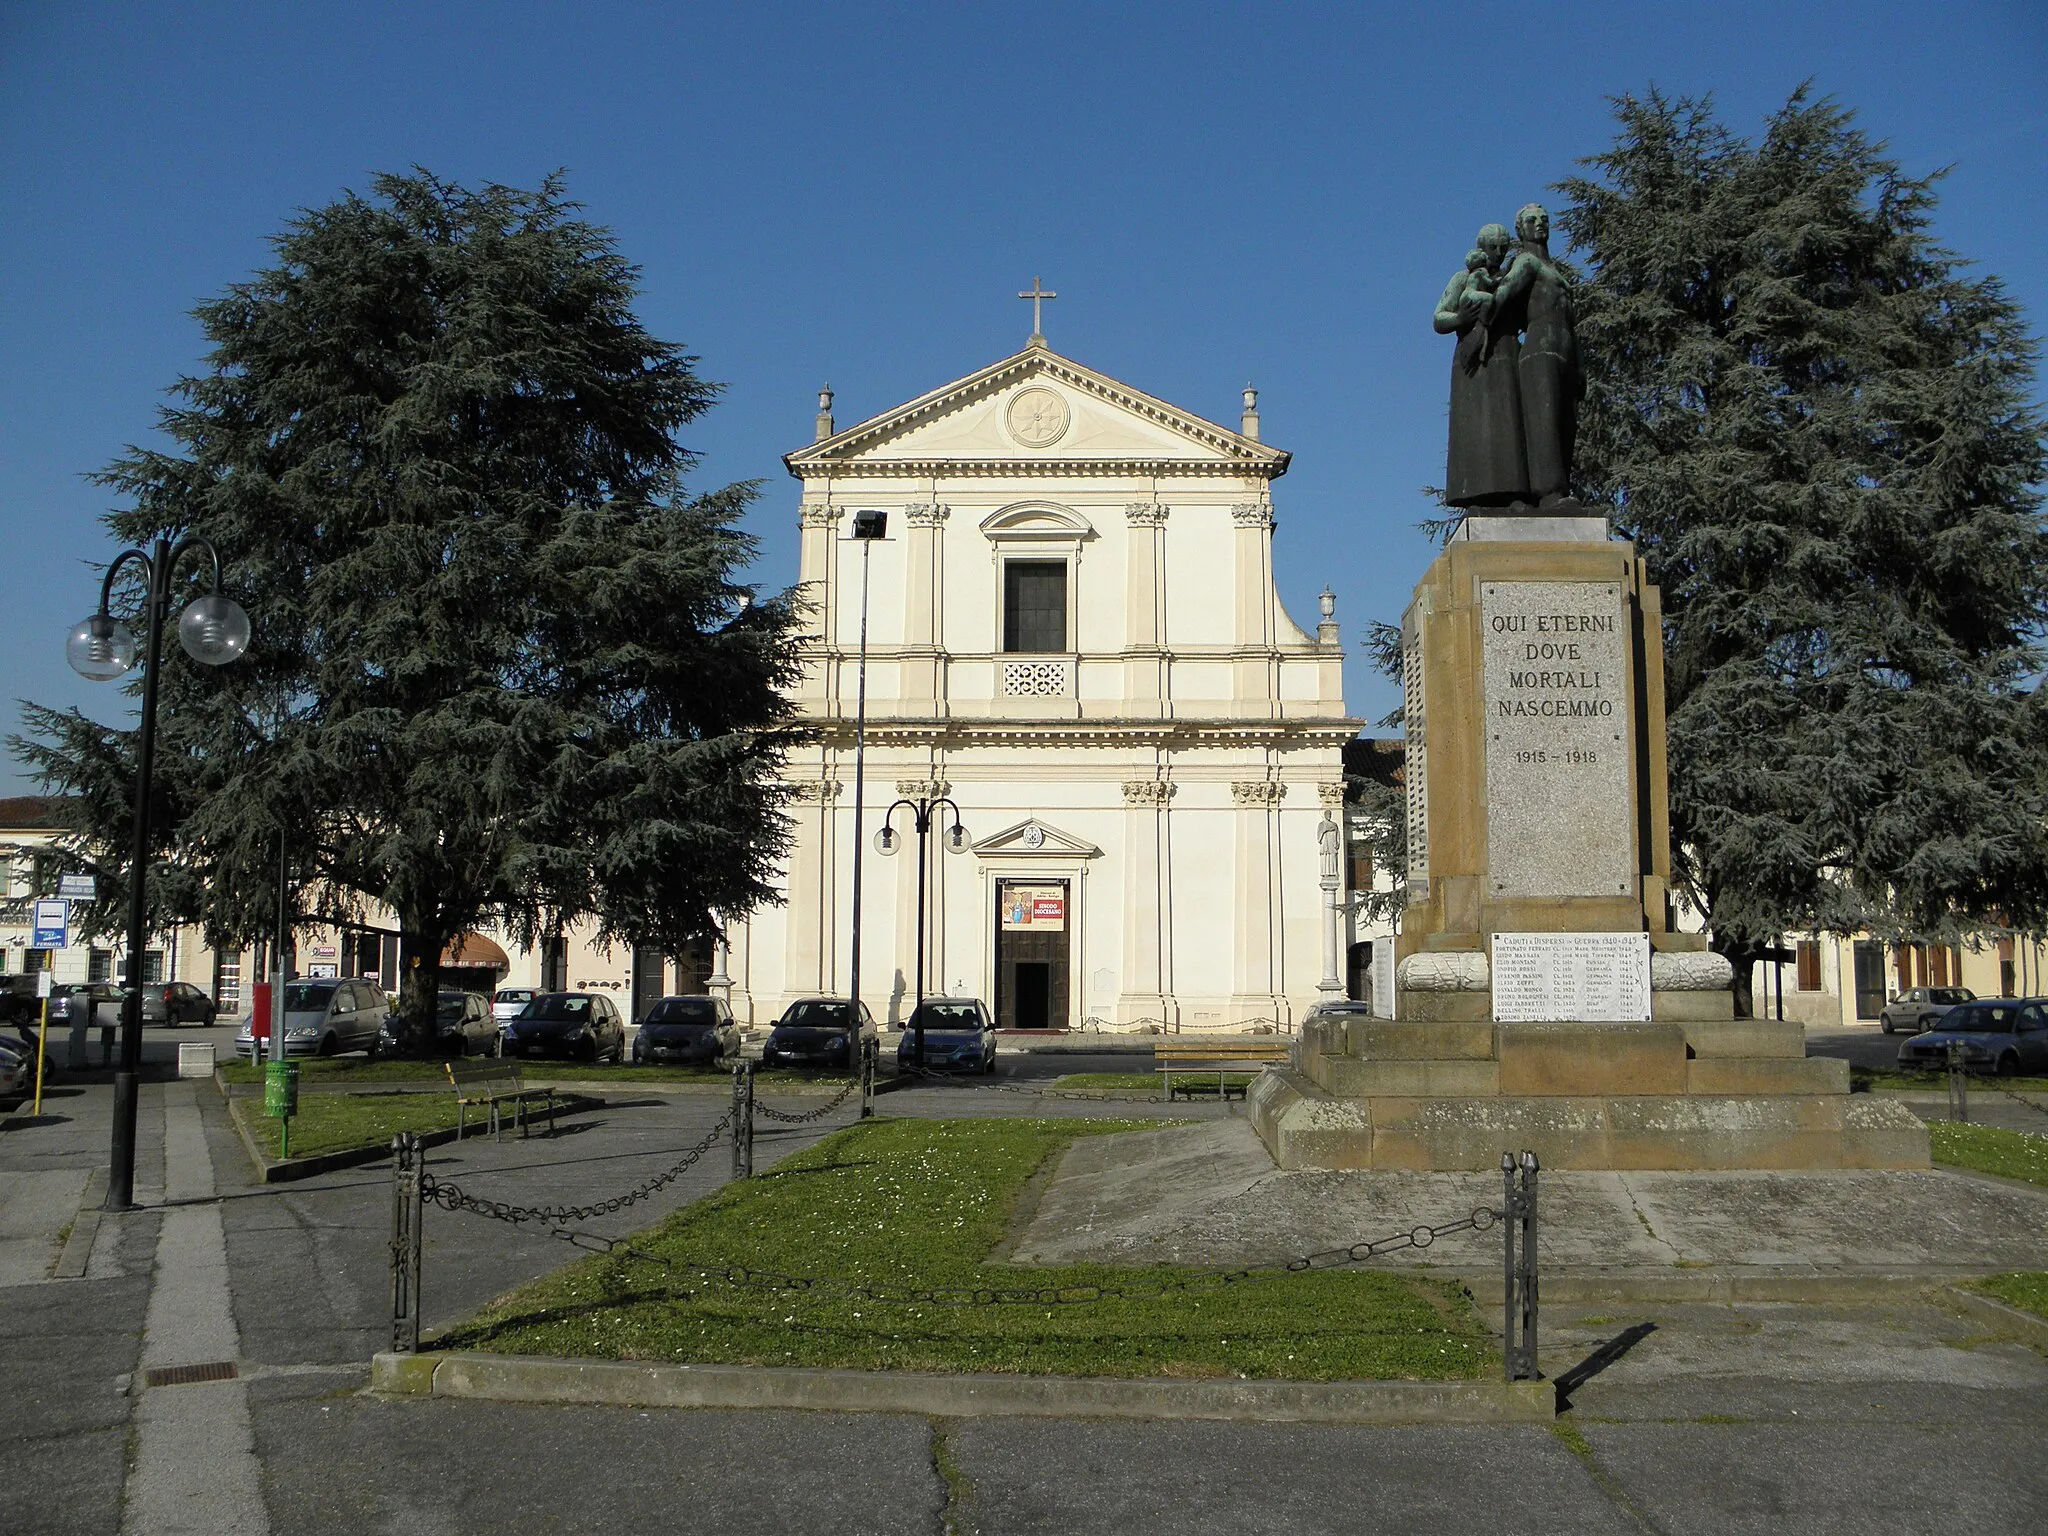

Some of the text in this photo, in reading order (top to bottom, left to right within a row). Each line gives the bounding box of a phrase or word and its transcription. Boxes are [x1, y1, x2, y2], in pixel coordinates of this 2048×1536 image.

[1491, 615, 1614, 634] QUI ETERNI
[1525, 643, 1581, 660] DOVE
[1509, 671, 1601, 689] MORTALI
[1498, 699, 1613, 718] NASCEMMO
[1515, 751, 1546, 764] 1915
[1565, 751, 1597, 764] 1918
[1504, 937, 1528, 945] CADUTI
[1534, 937, 1565, 945] DISPERSI
